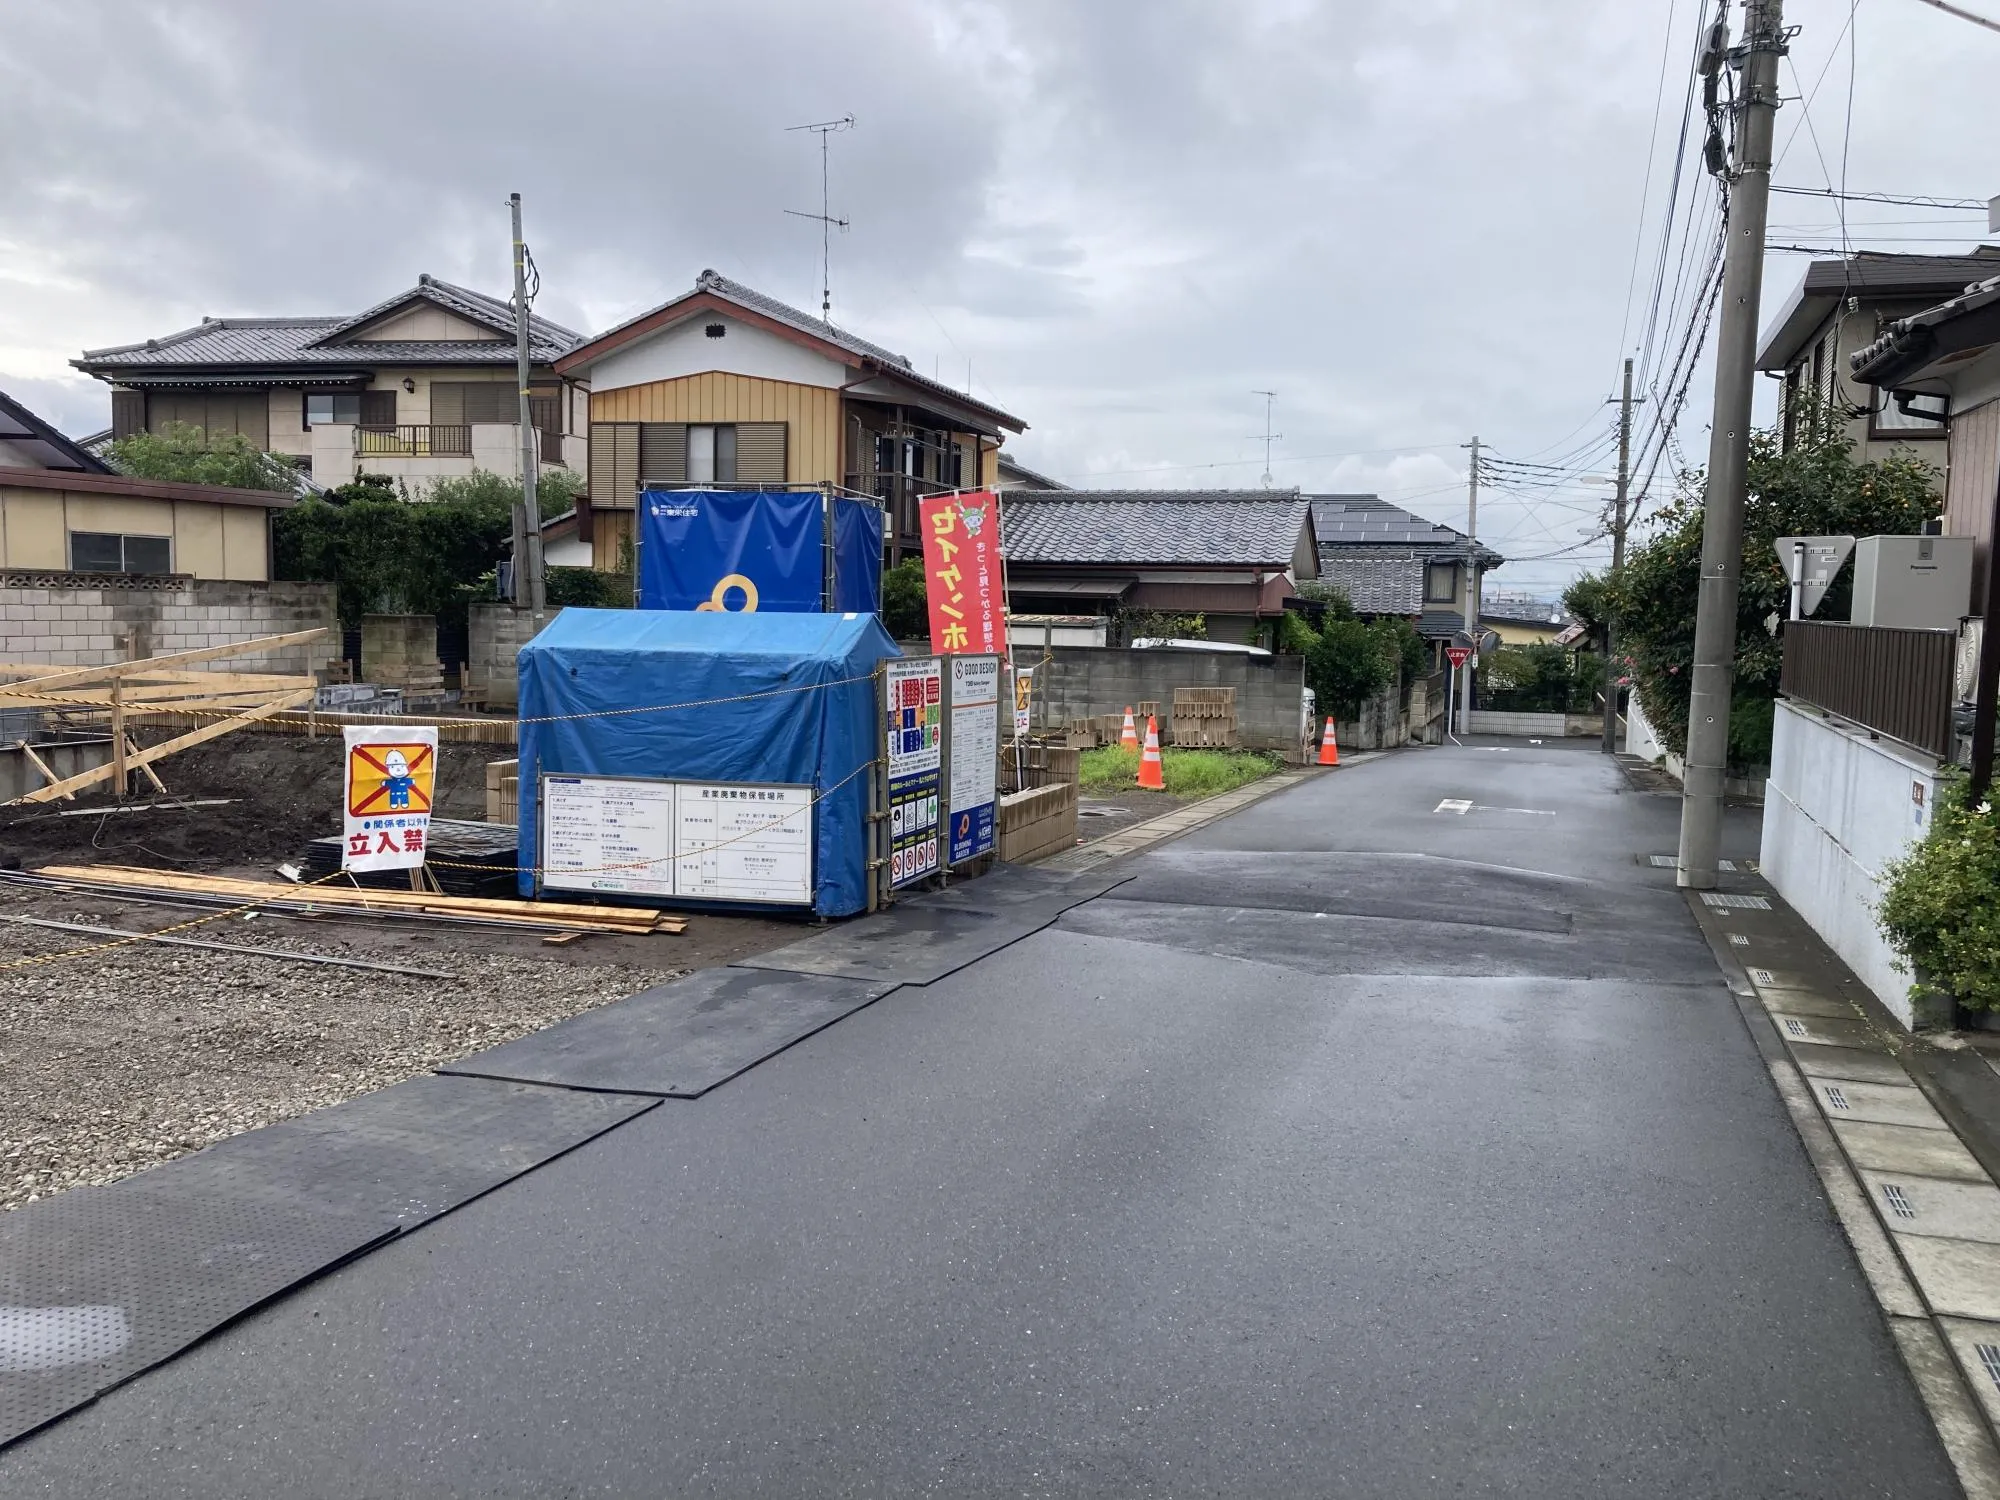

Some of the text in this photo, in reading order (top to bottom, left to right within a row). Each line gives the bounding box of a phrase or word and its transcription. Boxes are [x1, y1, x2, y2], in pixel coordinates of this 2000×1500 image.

[666, 509, 698, 517] 東栄住宅
[965, 662, 997, 676] GOOD DESIGN
[702, 789, 785, 801] 産業廃棄物保管場所
[347, 829, 426, 856] 立入禁
